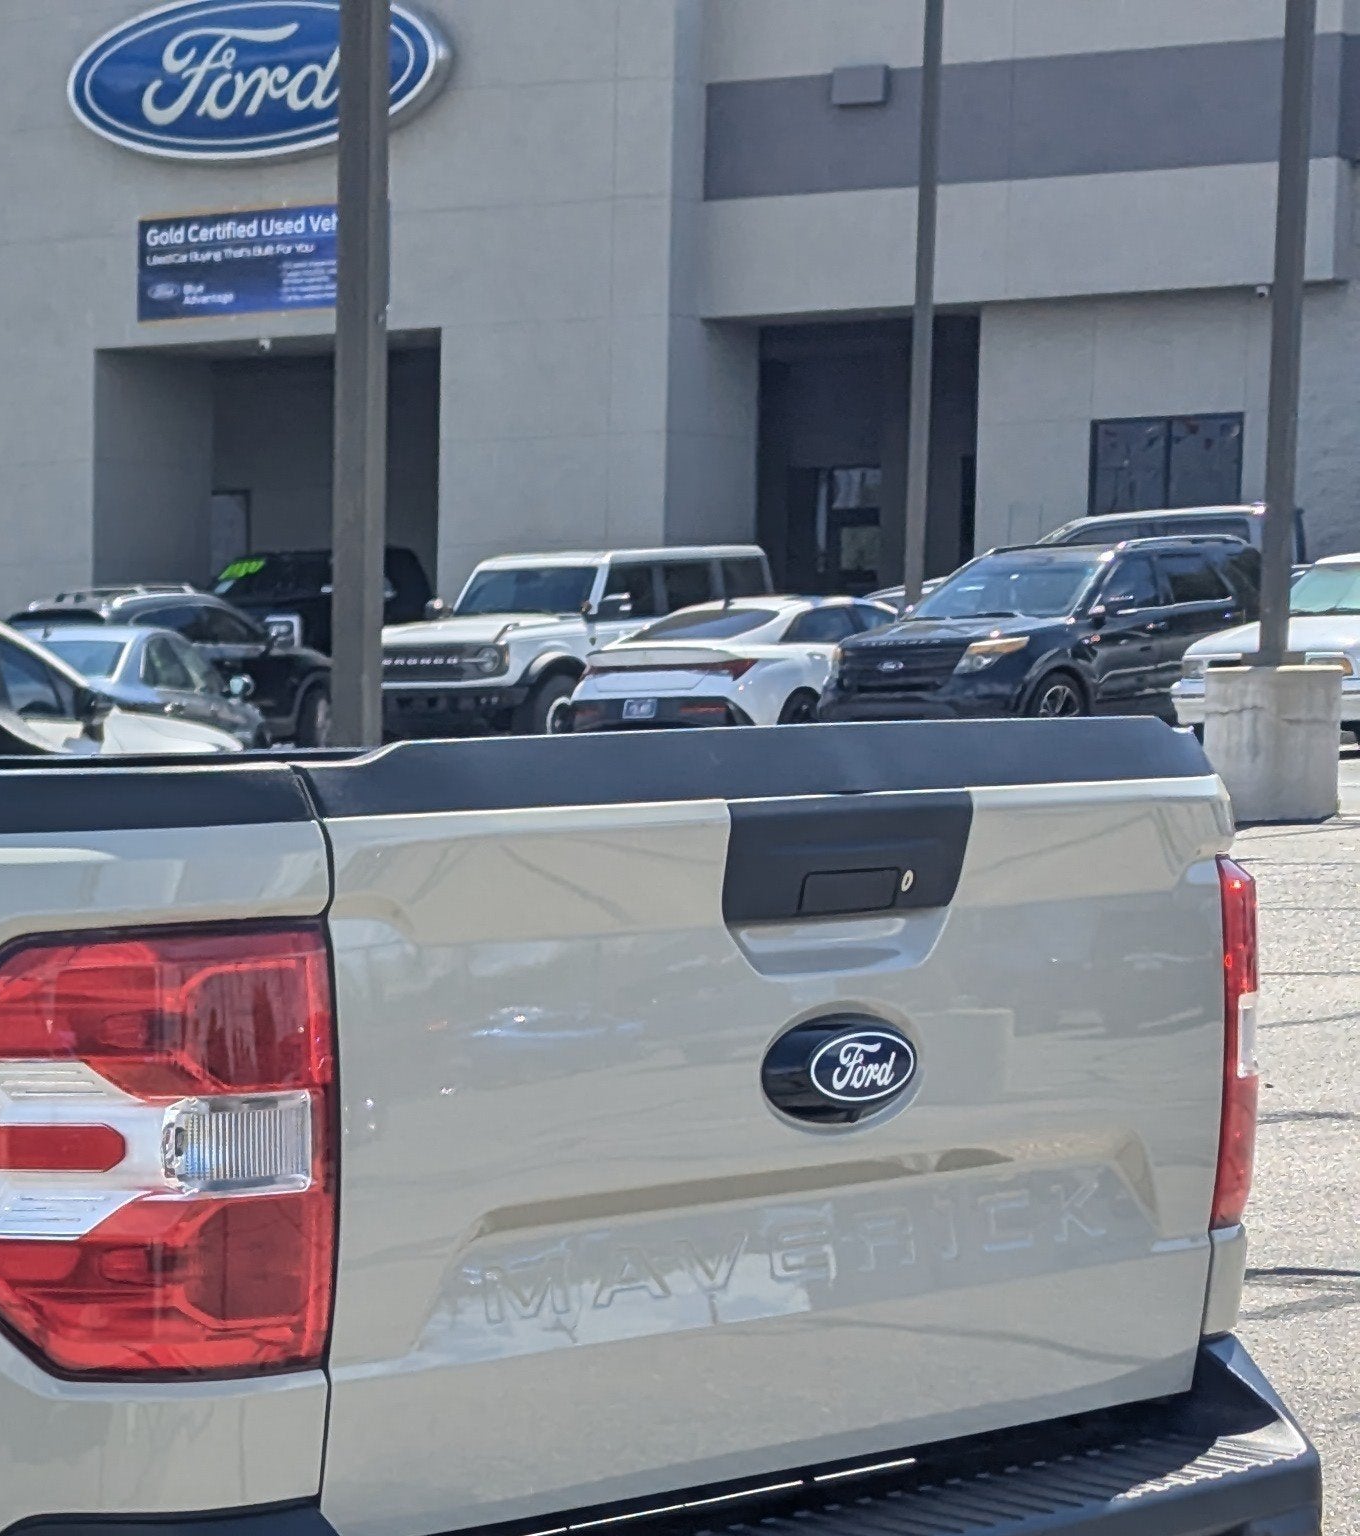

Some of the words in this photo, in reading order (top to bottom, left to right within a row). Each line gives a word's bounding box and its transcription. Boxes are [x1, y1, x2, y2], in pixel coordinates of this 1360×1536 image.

[142, 22, 340, 126] Ford
[146, 225, 185, 247] Gold
[187, 218, 258, 243] Certified
[261, 218, 306, 236] Used
[831, 1042, 897, 1091] Ford
[481, 1178, 1108, 1325] MAVERICK
